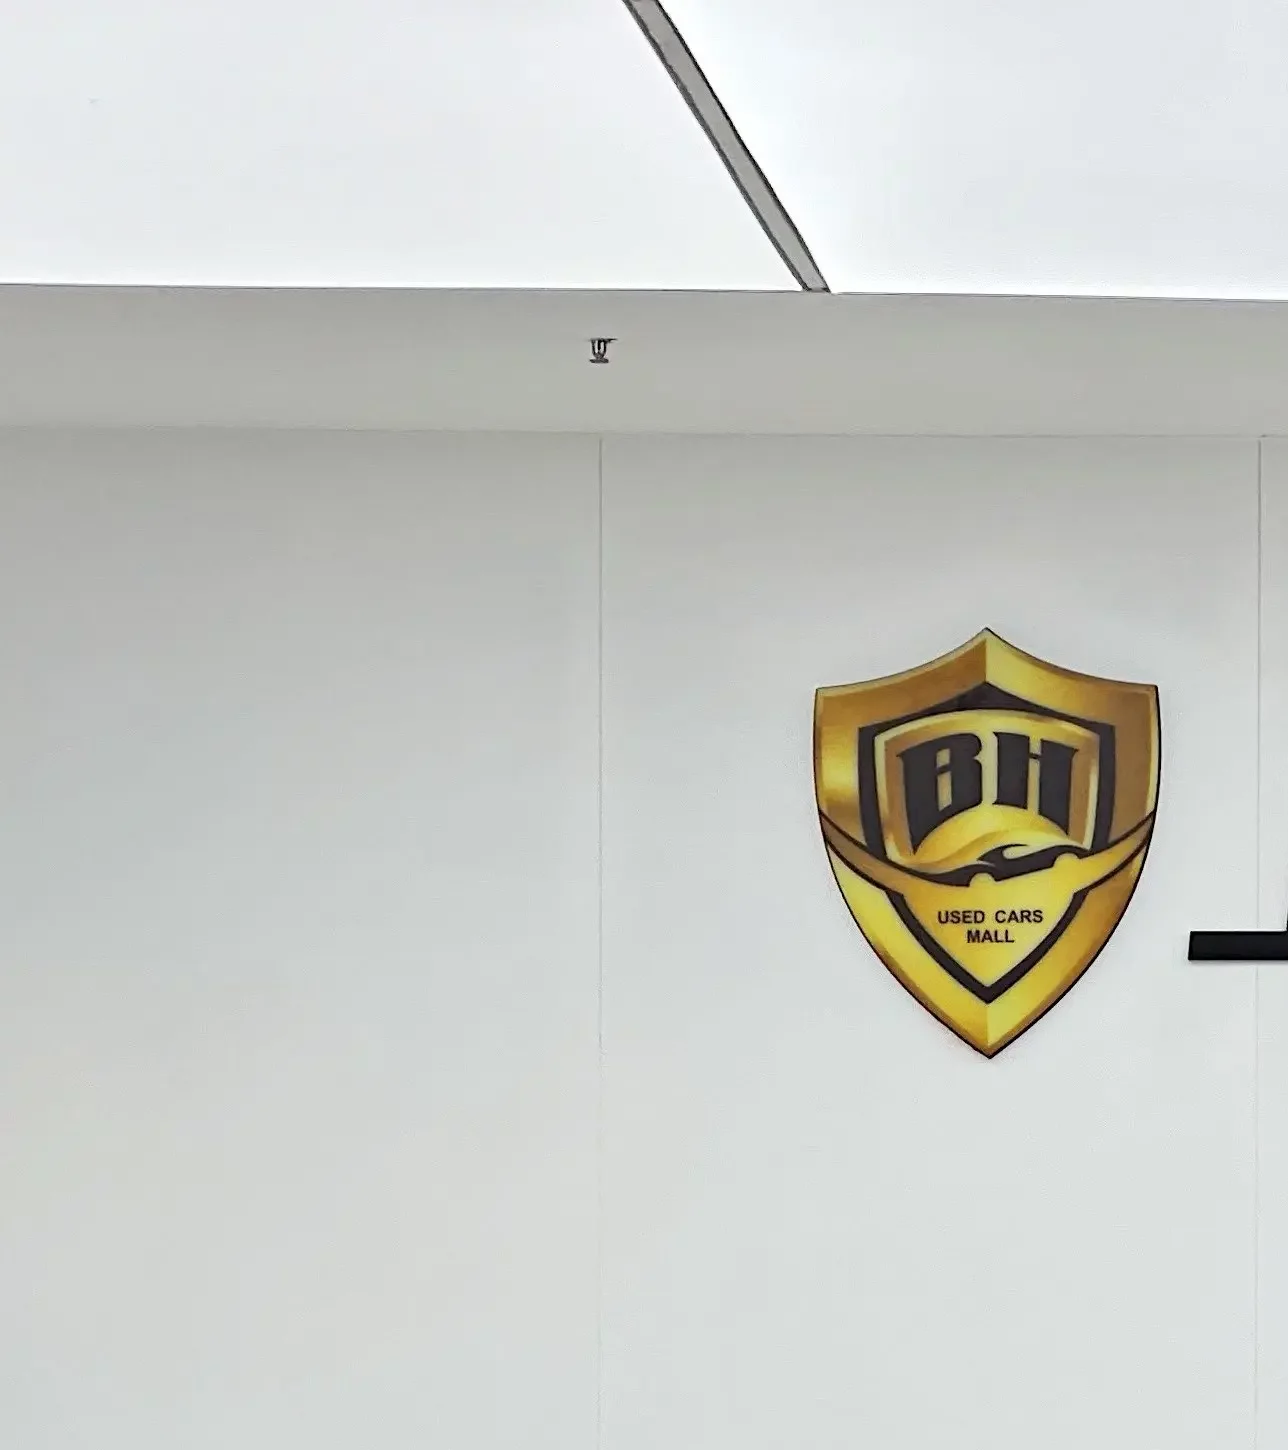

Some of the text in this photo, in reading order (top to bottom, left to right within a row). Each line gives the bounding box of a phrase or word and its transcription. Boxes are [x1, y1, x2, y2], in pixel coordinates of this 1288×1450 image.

[896, 731, 1080, 855] BH
[937, 909, 1044, 925] USED CARS
[966, 929, 1015, 944] MALL
